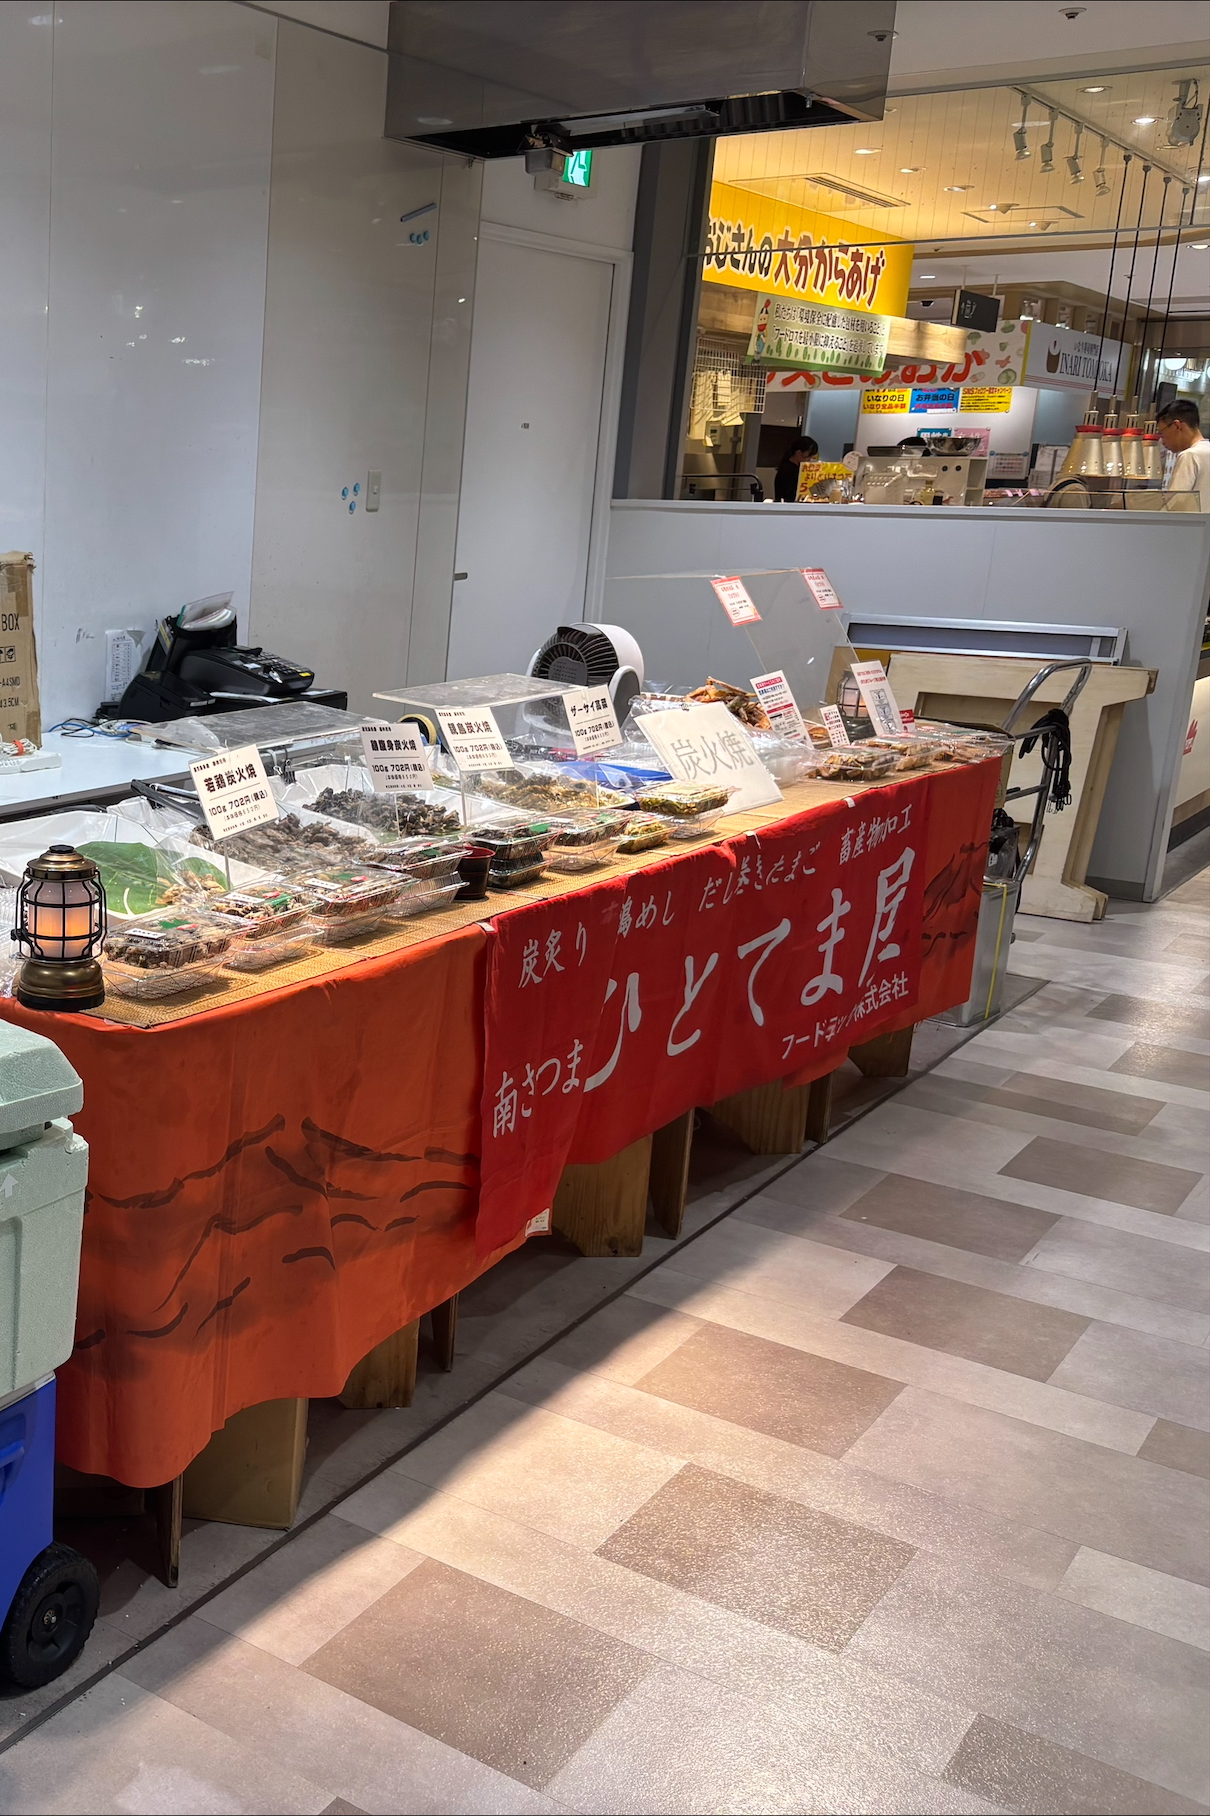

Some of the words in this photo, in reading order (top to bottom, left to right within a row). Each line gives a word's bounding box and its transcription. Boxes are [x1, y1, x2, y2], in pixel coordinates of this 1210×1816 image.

[1060, 352, 1082, 377] INARI
[1082, 357, 1112, 382] TOMOKA
[866, 394, 905, 402] いなりの日
[1, 613, 20, 631] BOX
[574, 729, 587, 737] 100g
[453, 745, 469, 753] 100g
[671, 730, 754, 781] 炭火焼
[203, 763, 257, 793] 若鶏炭火焼
[371, 764, 389, 772] 100g
[390, 763, 426, 773] 702円(税込)
[208, 805, 227, 817] 100g
[228, 789, 268, 810] 702円(税込)
[518, 920, 588, 989] 炭炙り
[698, 840, 821, 912] だし巻きたまご
[838, 803, 913, 867] 畜産物加工
[583, 846, 917, 1093] ひとてま屋
[493, 1039, 584, 1138] 南さつま
